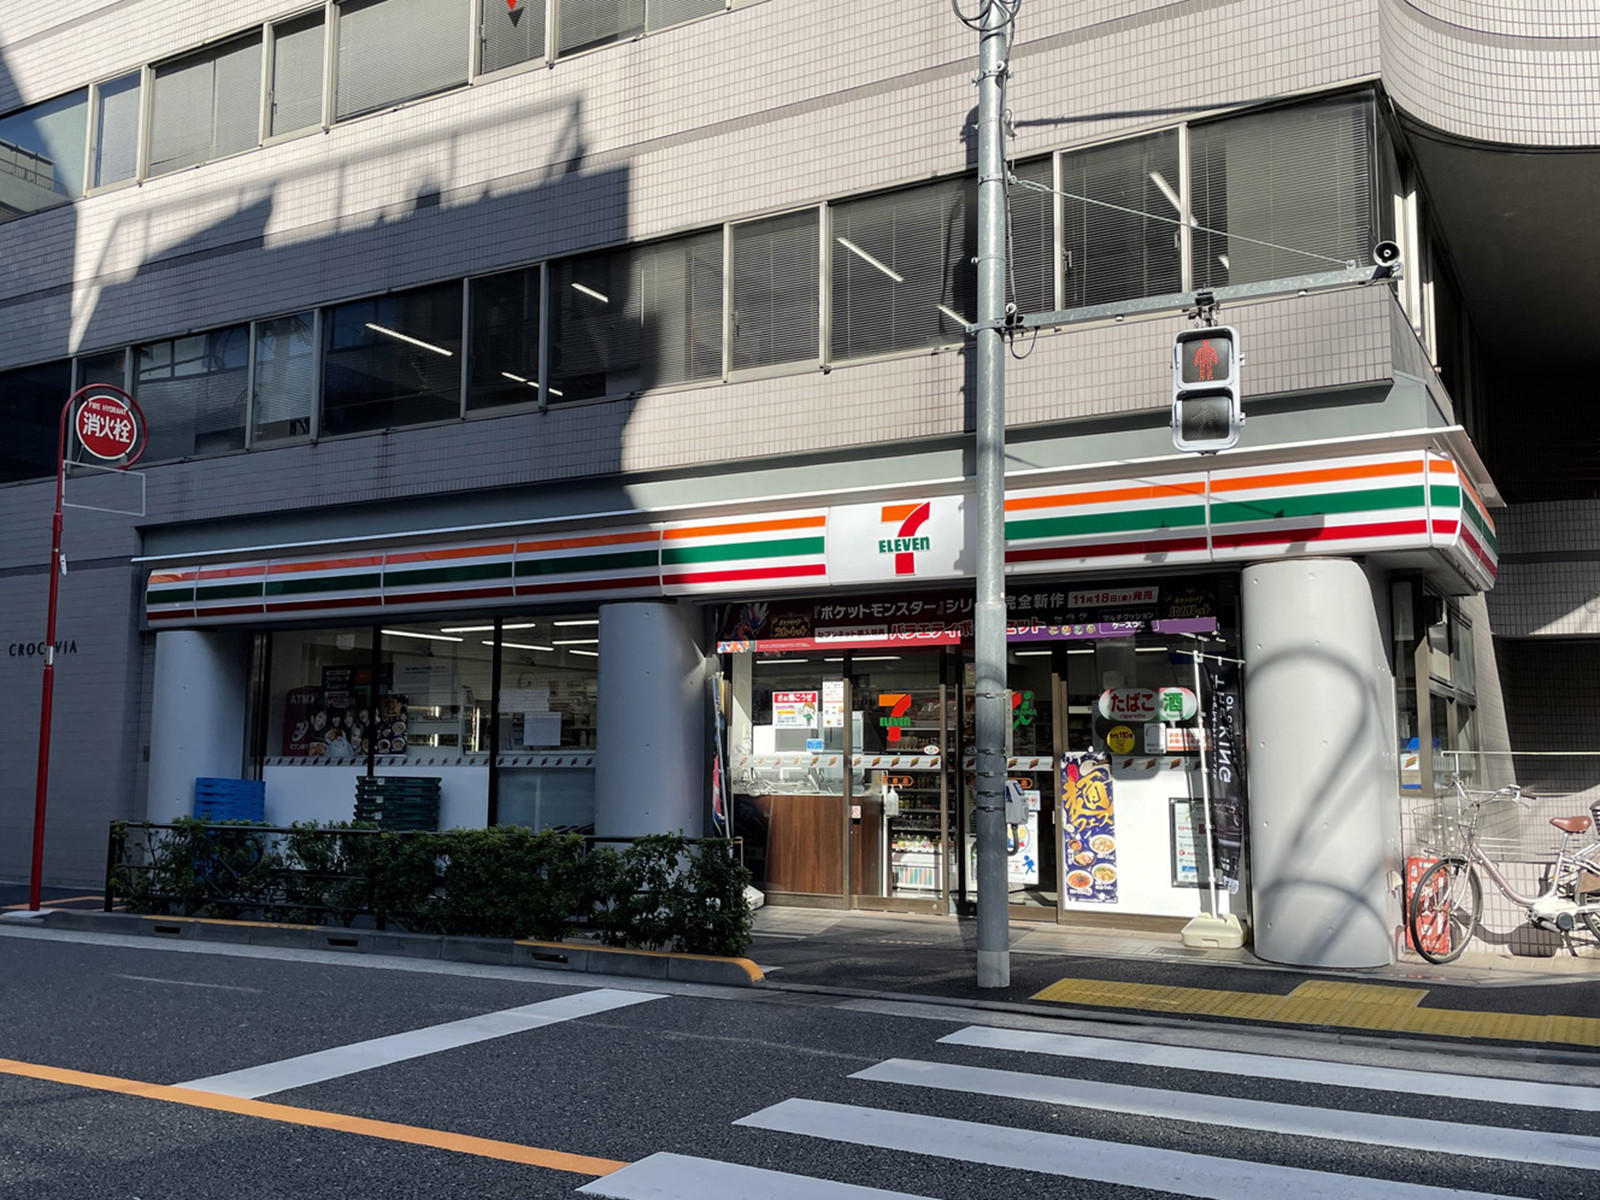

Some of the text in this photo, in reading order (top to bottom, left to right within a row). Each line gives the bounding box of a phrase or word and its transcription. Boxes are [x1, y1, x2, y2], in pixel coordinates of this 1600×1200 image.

[88, 401, 128, 415] FIRE HYDRANT
[83, 411, 131, 443] 消火栓
[881, 501, 930, 574] 7
[9, 640, 78, 657] CROCVIA
[1111, 692, 1183, 712] たばこ 酒
[1072, 812, 1114, 832] フェス
